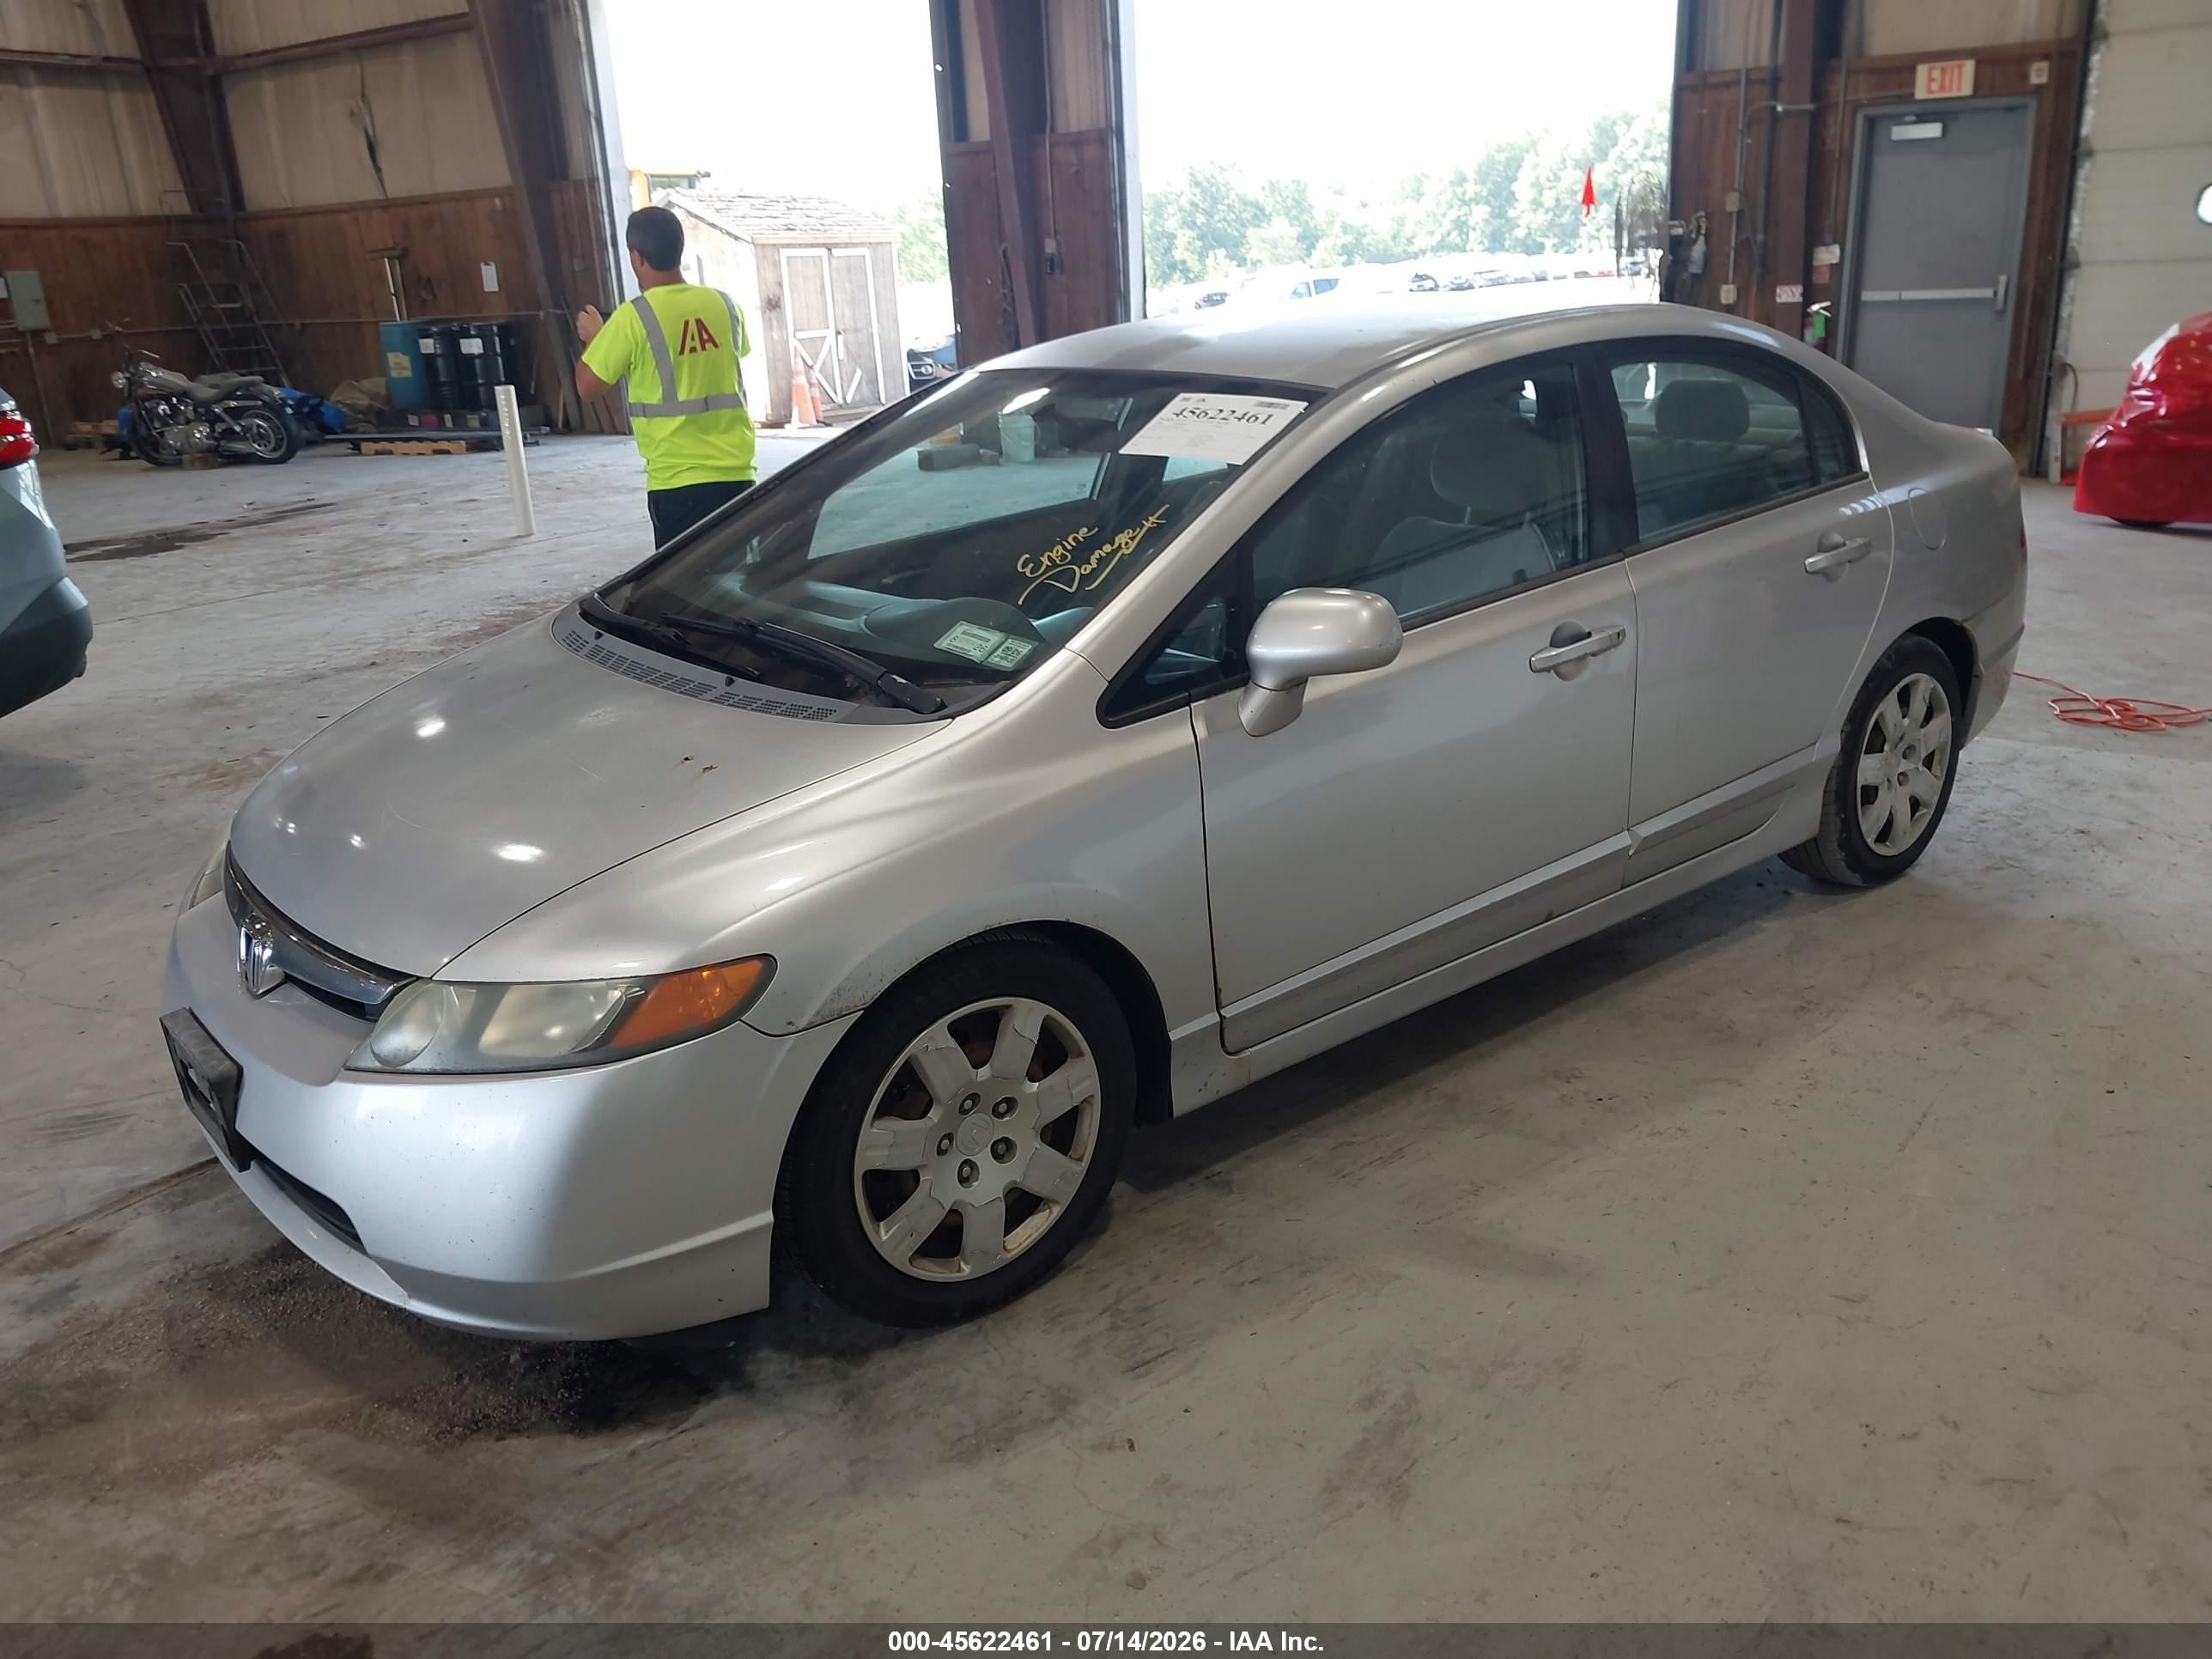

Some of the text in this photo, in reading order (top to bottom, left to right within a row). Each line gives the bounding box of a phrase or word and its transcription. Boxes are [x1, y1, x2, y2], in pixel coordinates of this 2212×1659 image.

[1926, 62, 1966, 96] EXIT
[1173, 406, 1274, 426] 45622461
[1017, 526, 1099, 579] Engine
